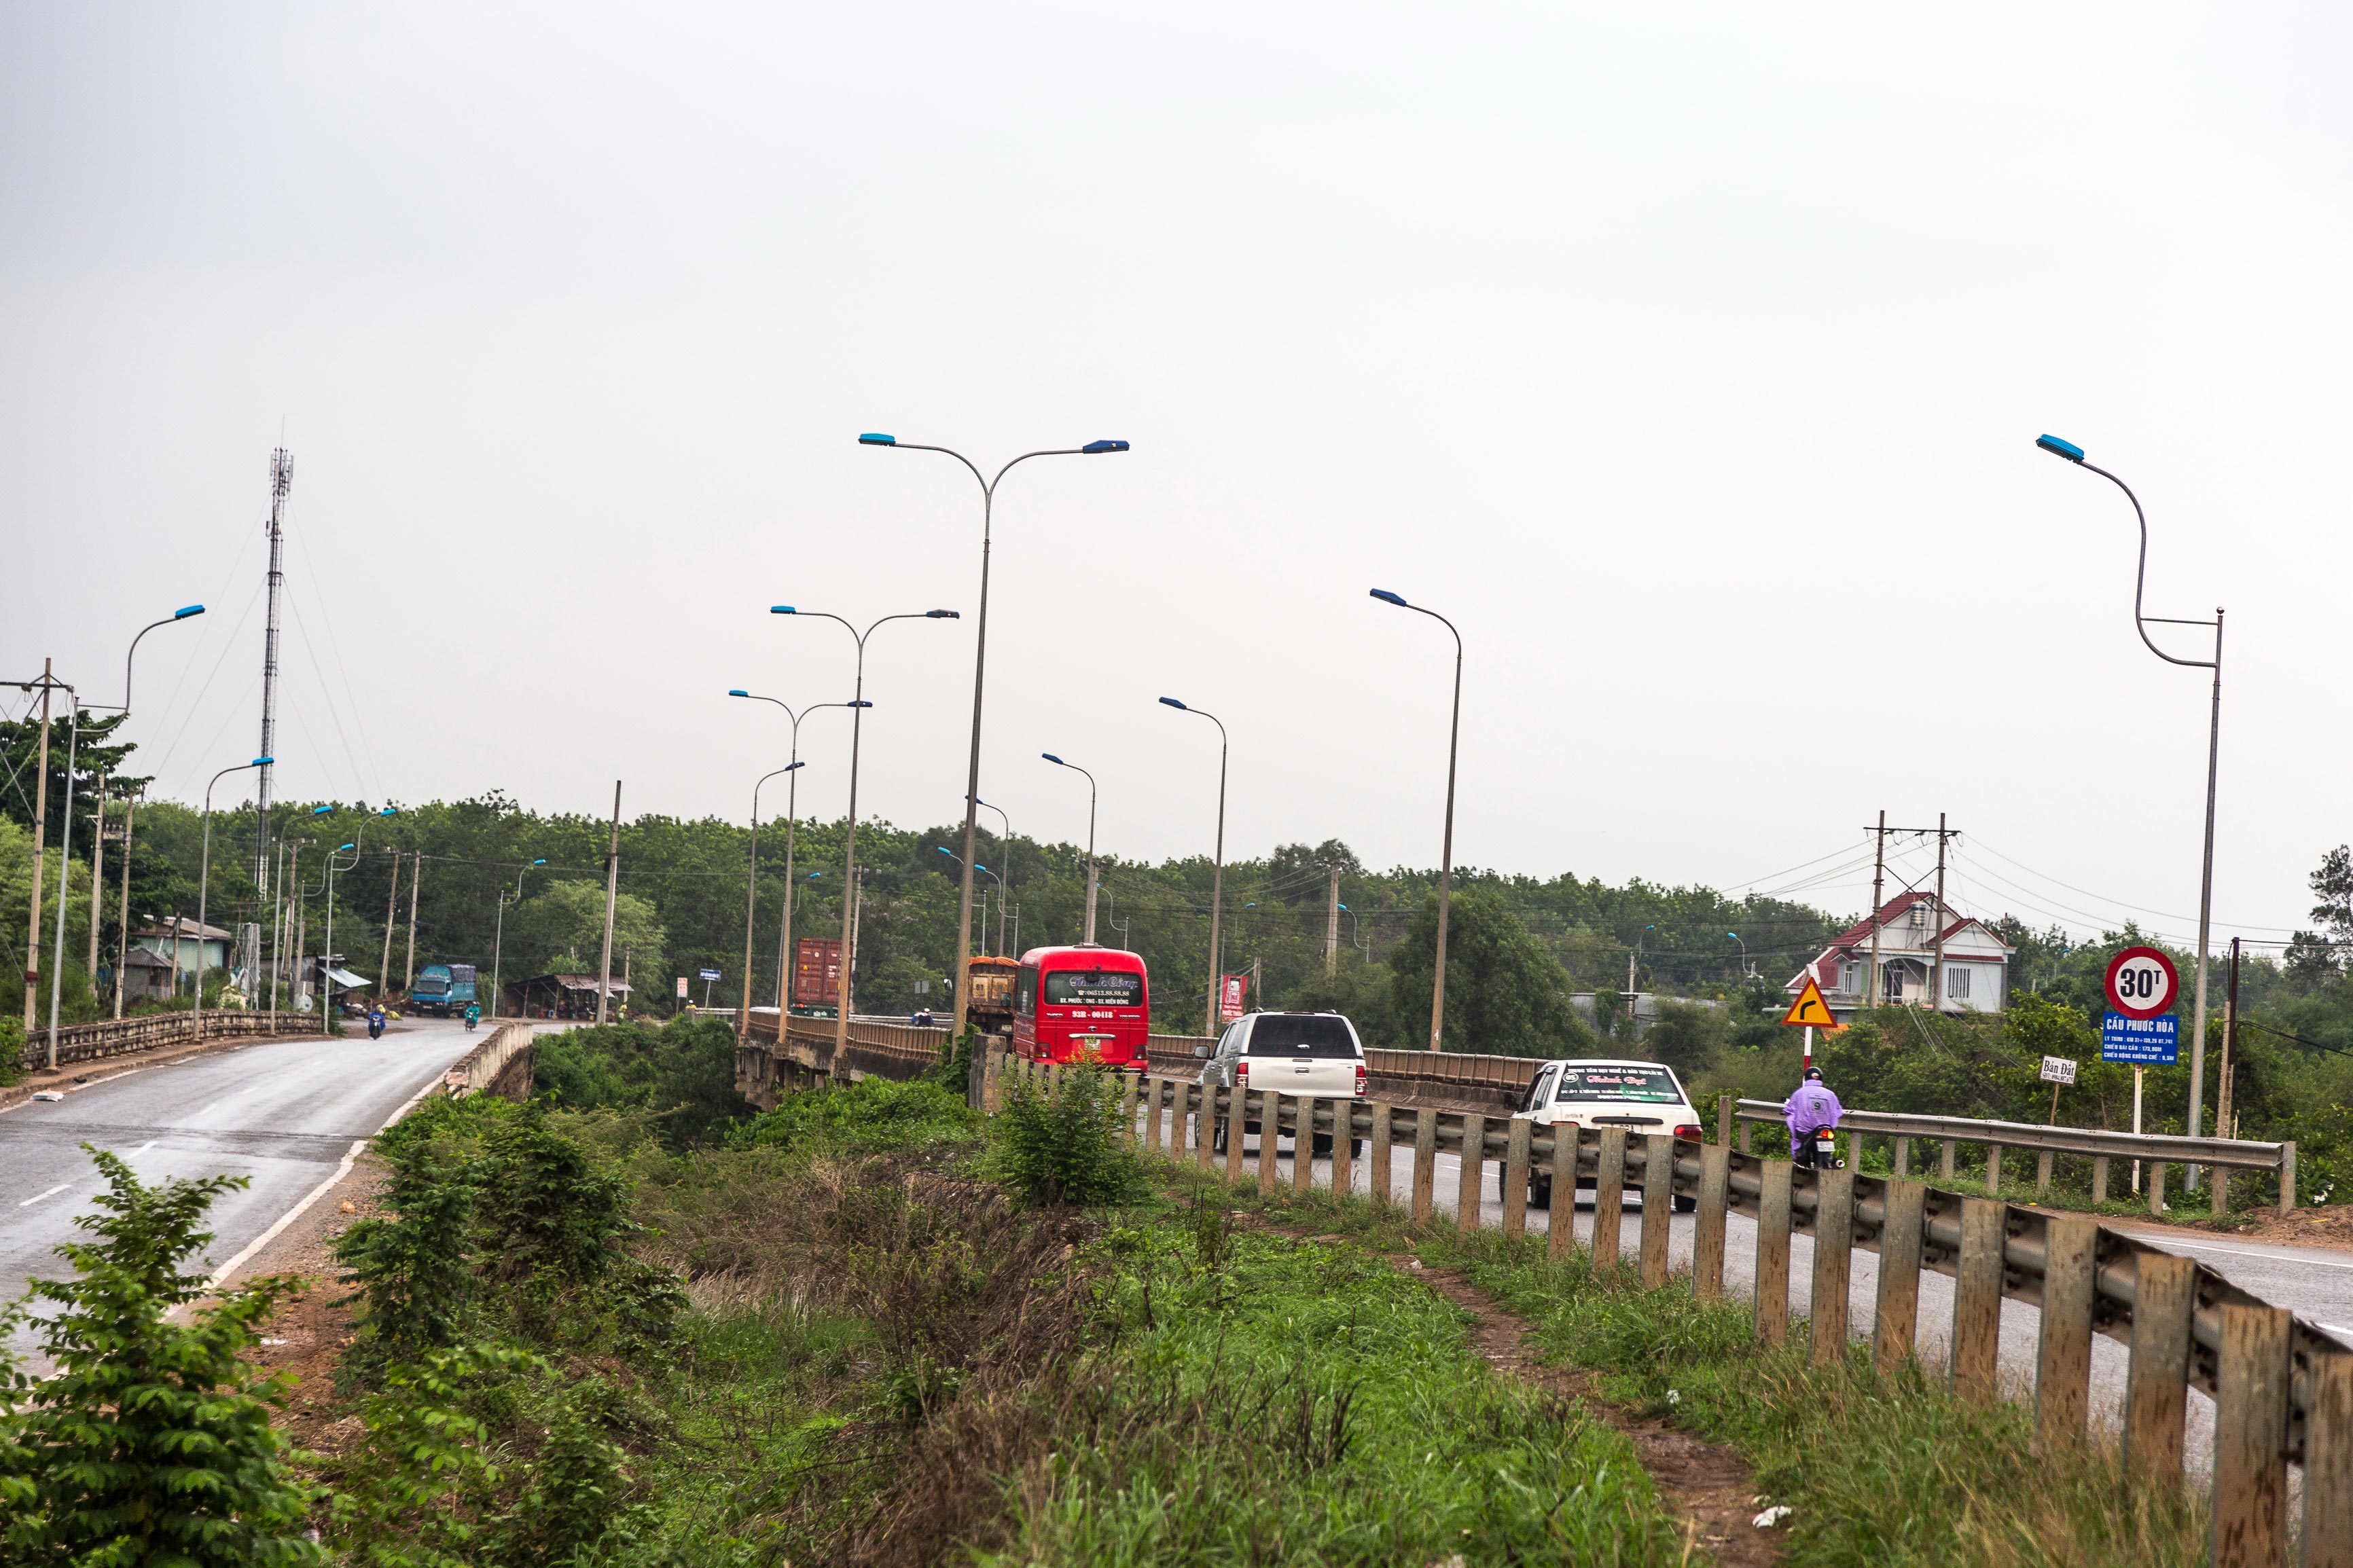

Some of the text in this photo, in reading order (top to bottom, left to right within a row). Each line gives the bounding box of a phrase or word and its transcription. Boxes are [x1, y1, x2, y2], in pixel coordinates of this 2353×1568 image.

[2120, 968, 2161, 998] 30T
[2106, 1016, 2124, 1030] CẦU
[2156, 1019, 2174, 1032] HÒA
[2043, 1060, 2074, 1076] Bán Đất
